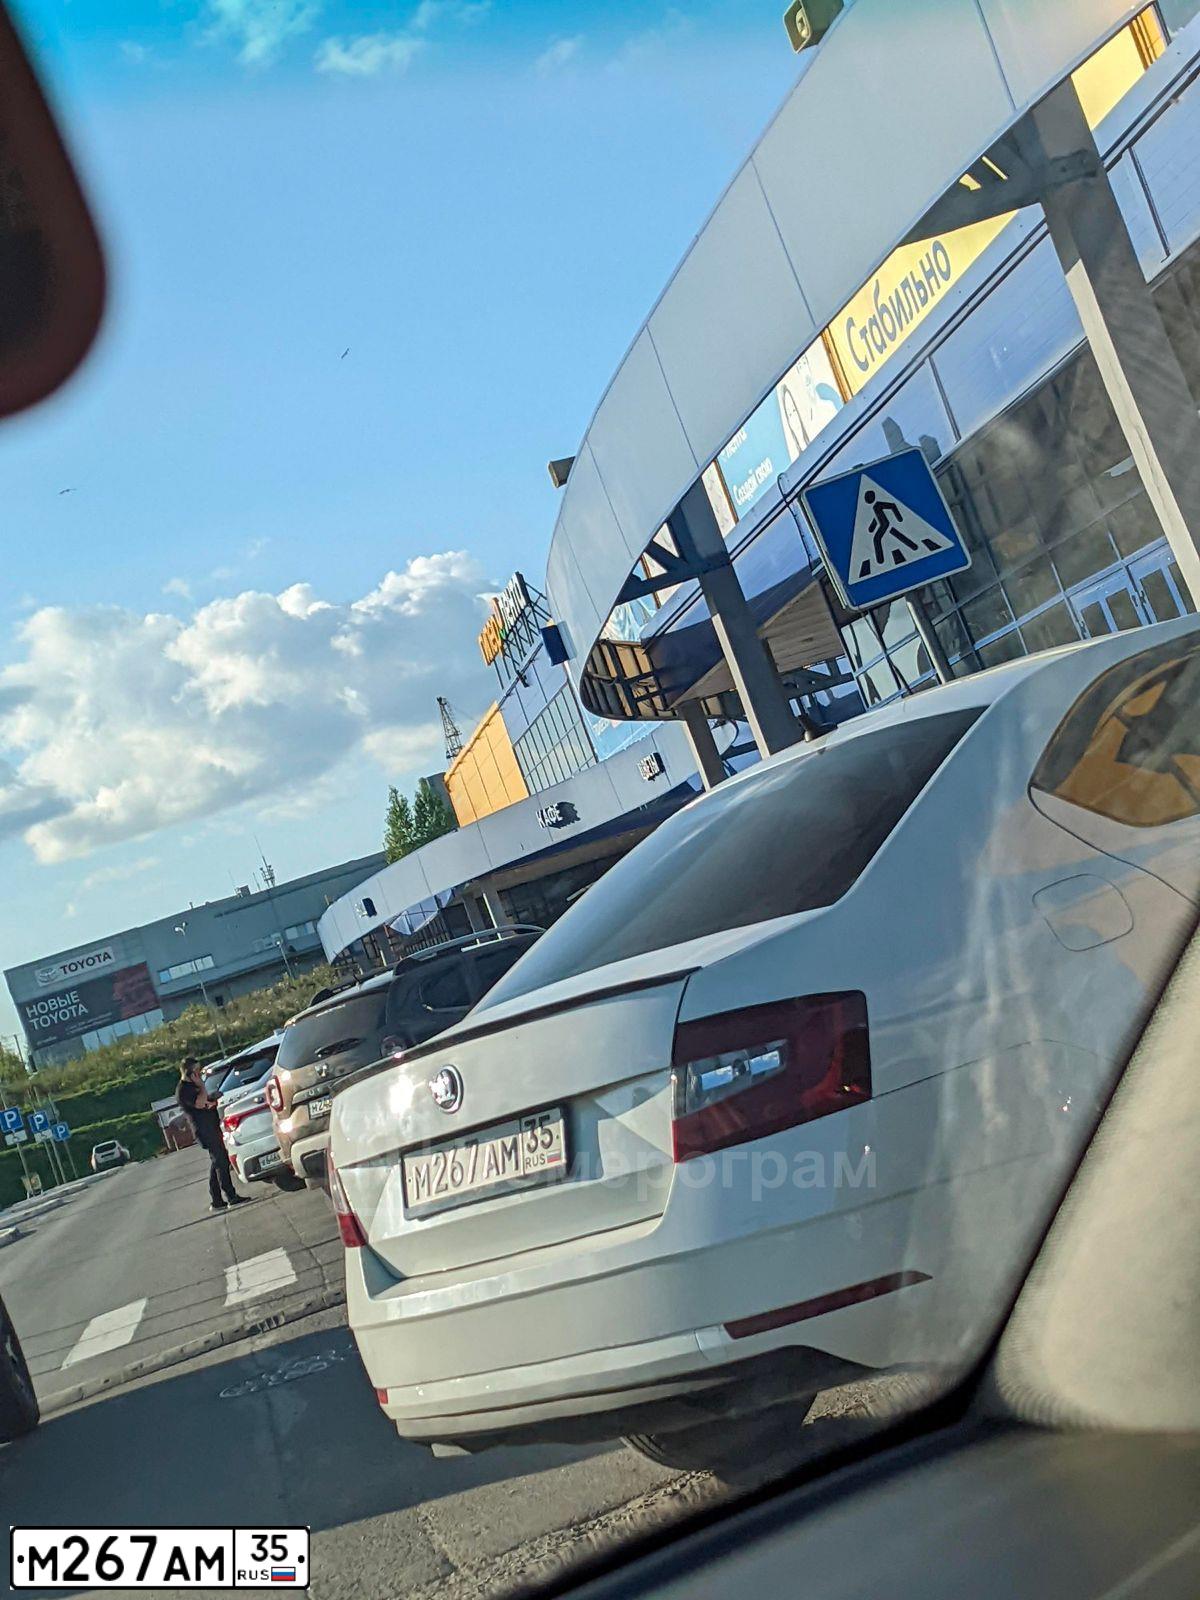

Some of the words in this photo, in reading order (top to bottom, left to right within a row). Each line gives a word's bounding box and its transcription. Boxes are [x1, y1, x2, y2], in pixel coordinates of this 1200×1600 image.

[845, 240, 951, 372] Стабильно
[60, 951, 112, 975] TOYOTA
[26, 990, 80, 1018] НОВЫЕ
[29, 1004, 88, 1030] TOYOTA
[4, 1110, 16, 1129] P
[33, 1114, 45, 1130] P
[57, 1125, 66, 1138] P
[413, 1136, 519, 1200] М267АМ
[523, 1115, 553, 1153] 35
[525, 1153, 546, 1169] RUS
